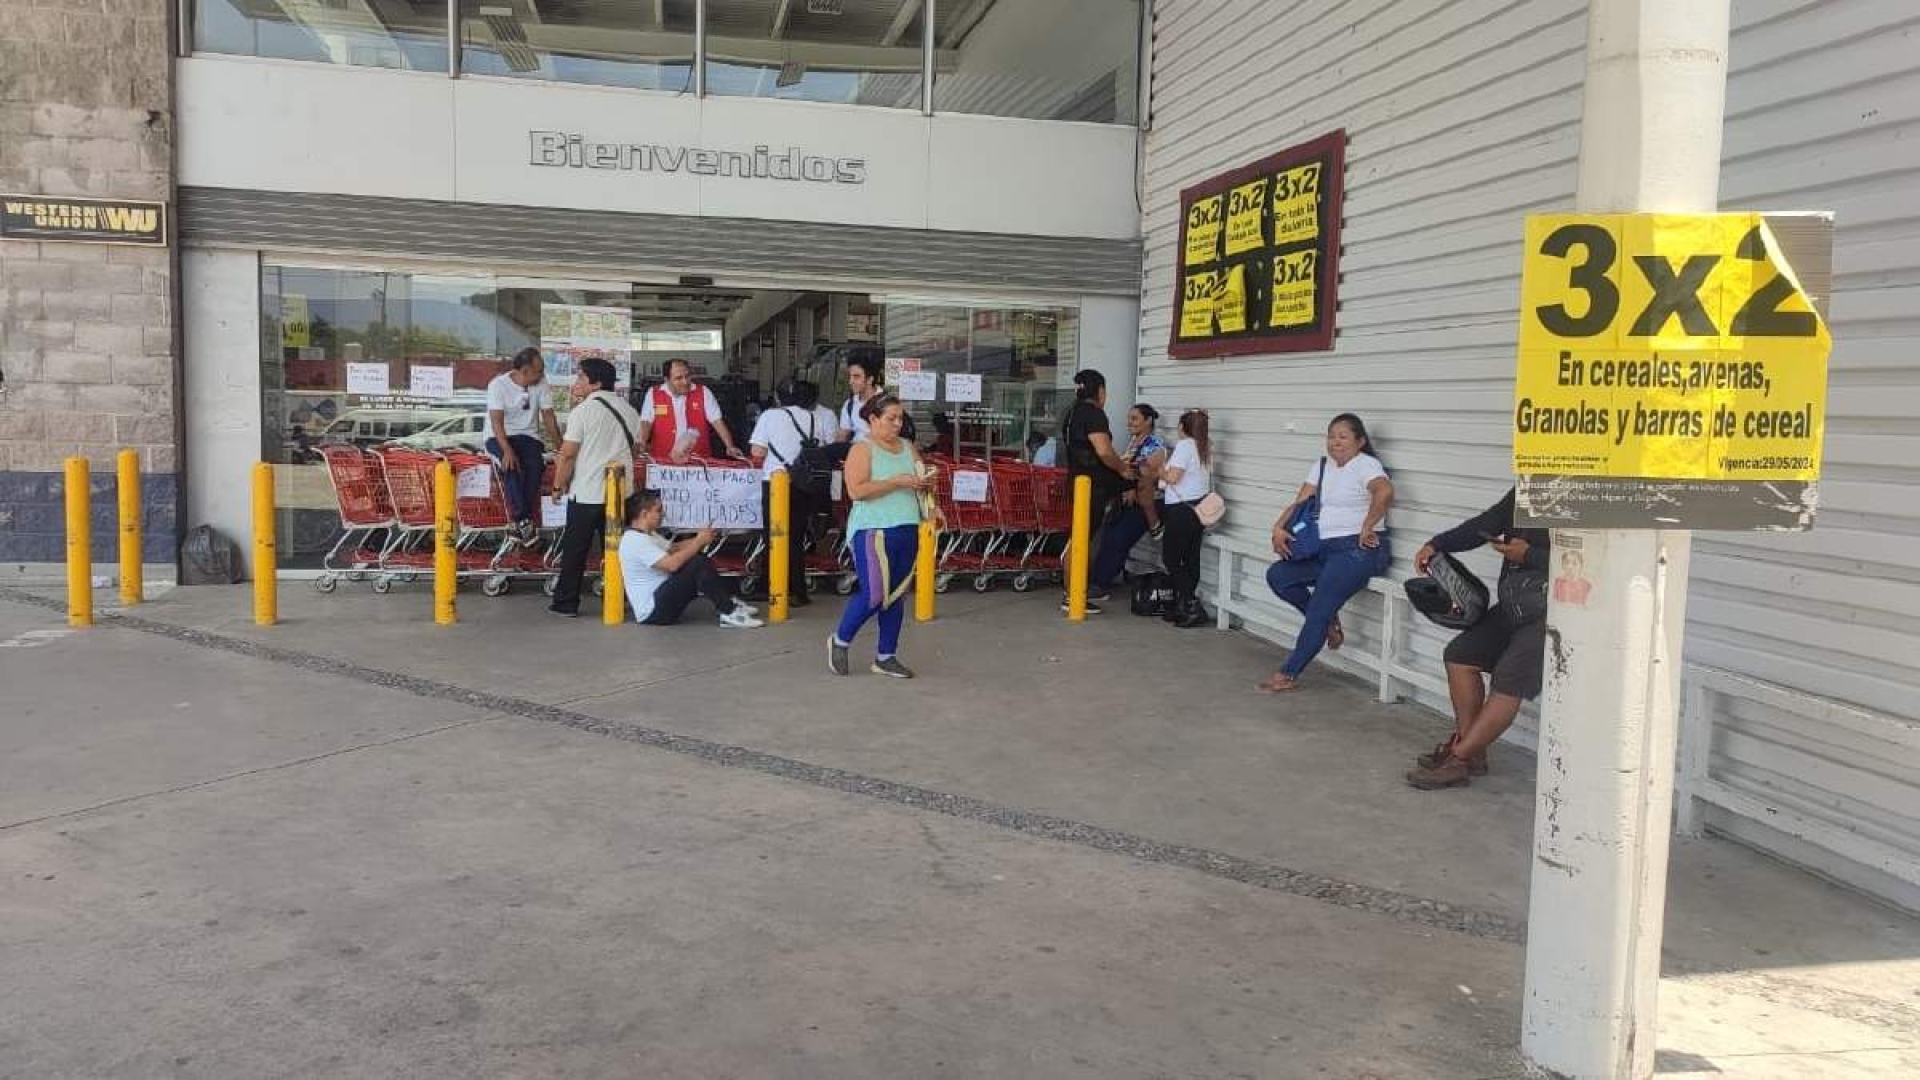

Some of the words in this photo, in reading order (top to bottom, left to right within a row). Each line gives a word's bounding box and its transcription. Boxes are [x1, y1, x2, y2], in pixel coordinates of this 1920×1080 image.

[530, 130, 866, 184] Bienvenidos
[1230, 184, 1263, 216] 3x2
[1275, 168, 1318, 200] 3x2
[6, 202, 97, 217] WESTERN
[35, 215, 97, 229] UNION
[1190, 200, 1219, 229] 3x2
[1275, 253, 1313, 285] 3x2
[1536, 224, 1817, 337] 3x2
[1558, 351, 1584, 386] En
[1517, 398, 1609, 435] Granolas
[1615, 408, 1630, 446] y
[1633, 401, 1703, 437] barras
[1713, 403, 1737, 438] de
[1743, 403, 1812, 438] cereal
